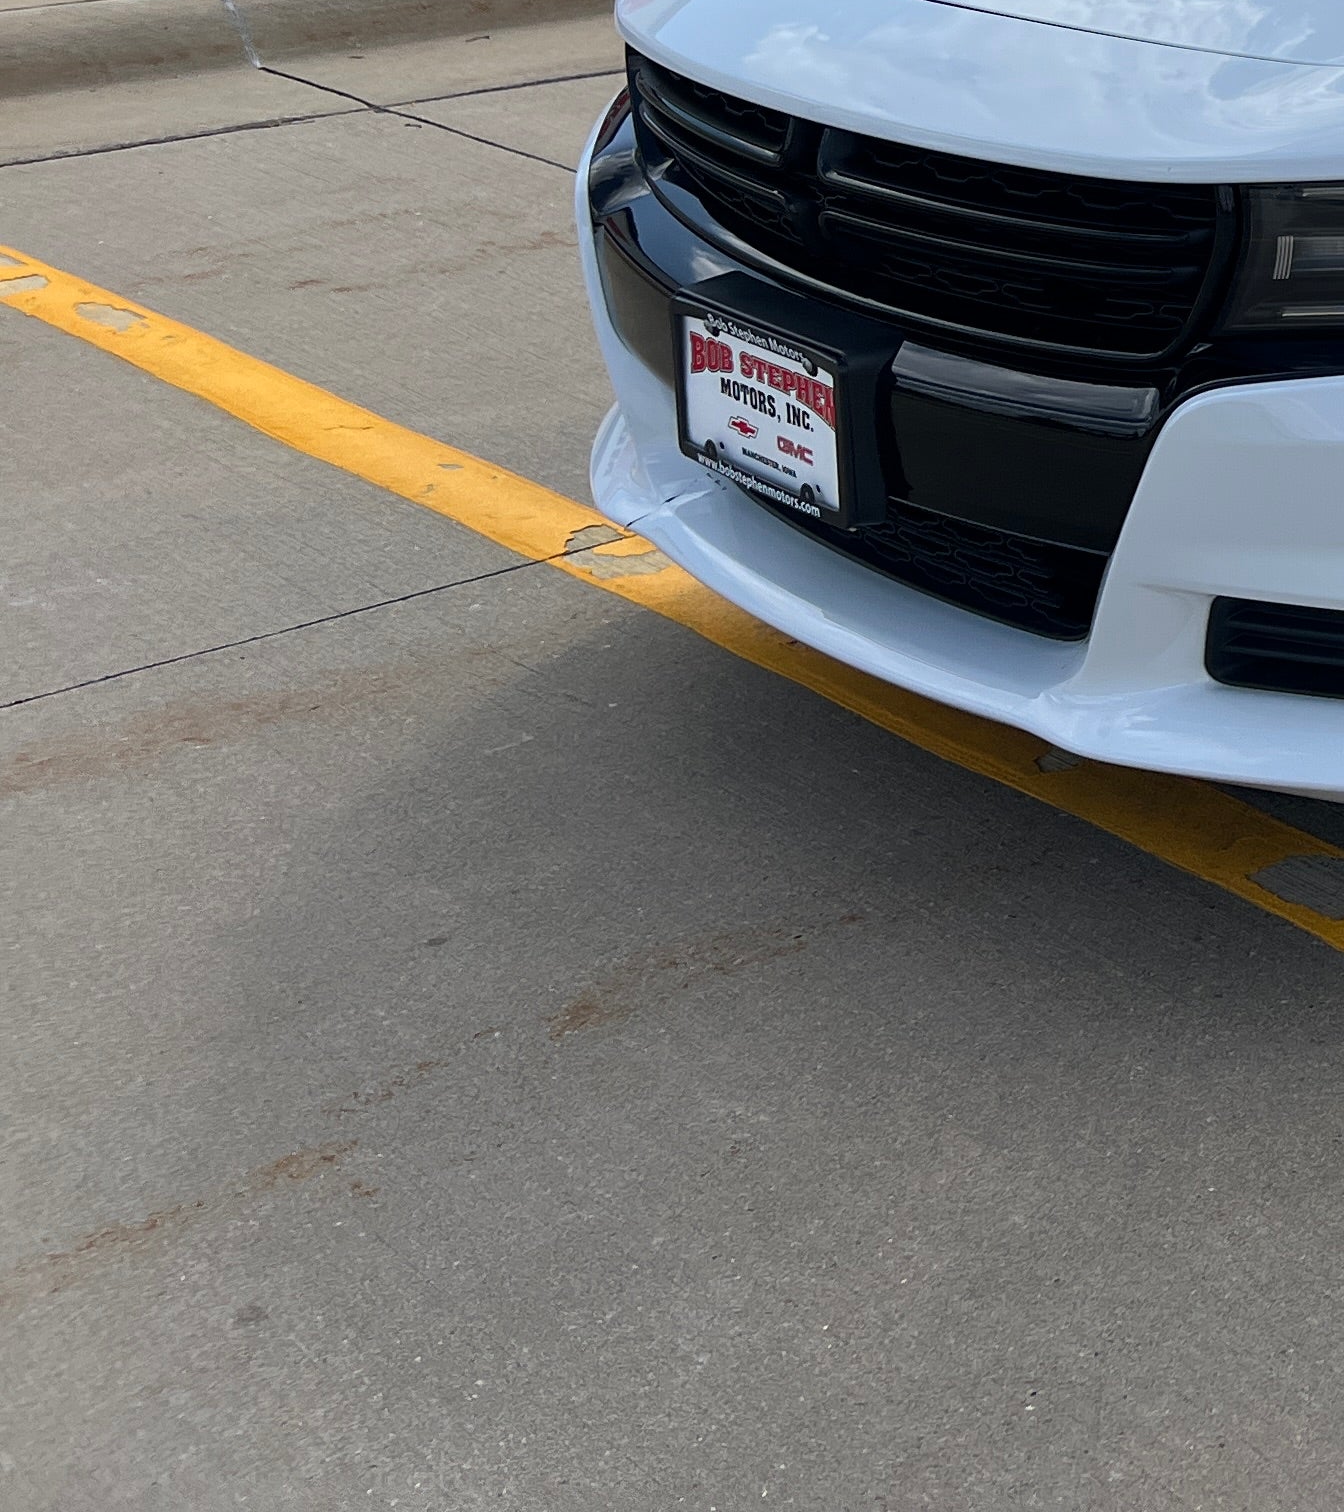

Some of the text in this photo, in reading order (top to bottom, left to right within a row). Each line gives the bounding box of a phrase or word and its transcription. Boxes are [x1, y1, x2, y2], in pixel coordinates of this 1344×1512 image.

[690, 331, 734, 374] BOB
[705, 313, 806, 363] Bob Stephen Motors
[720, 377, 814, 433] MOTORS, INC.
[776, 435, 813, 466] GMC
[697, 453, 821, 518] www.bobstephenmotors.com
